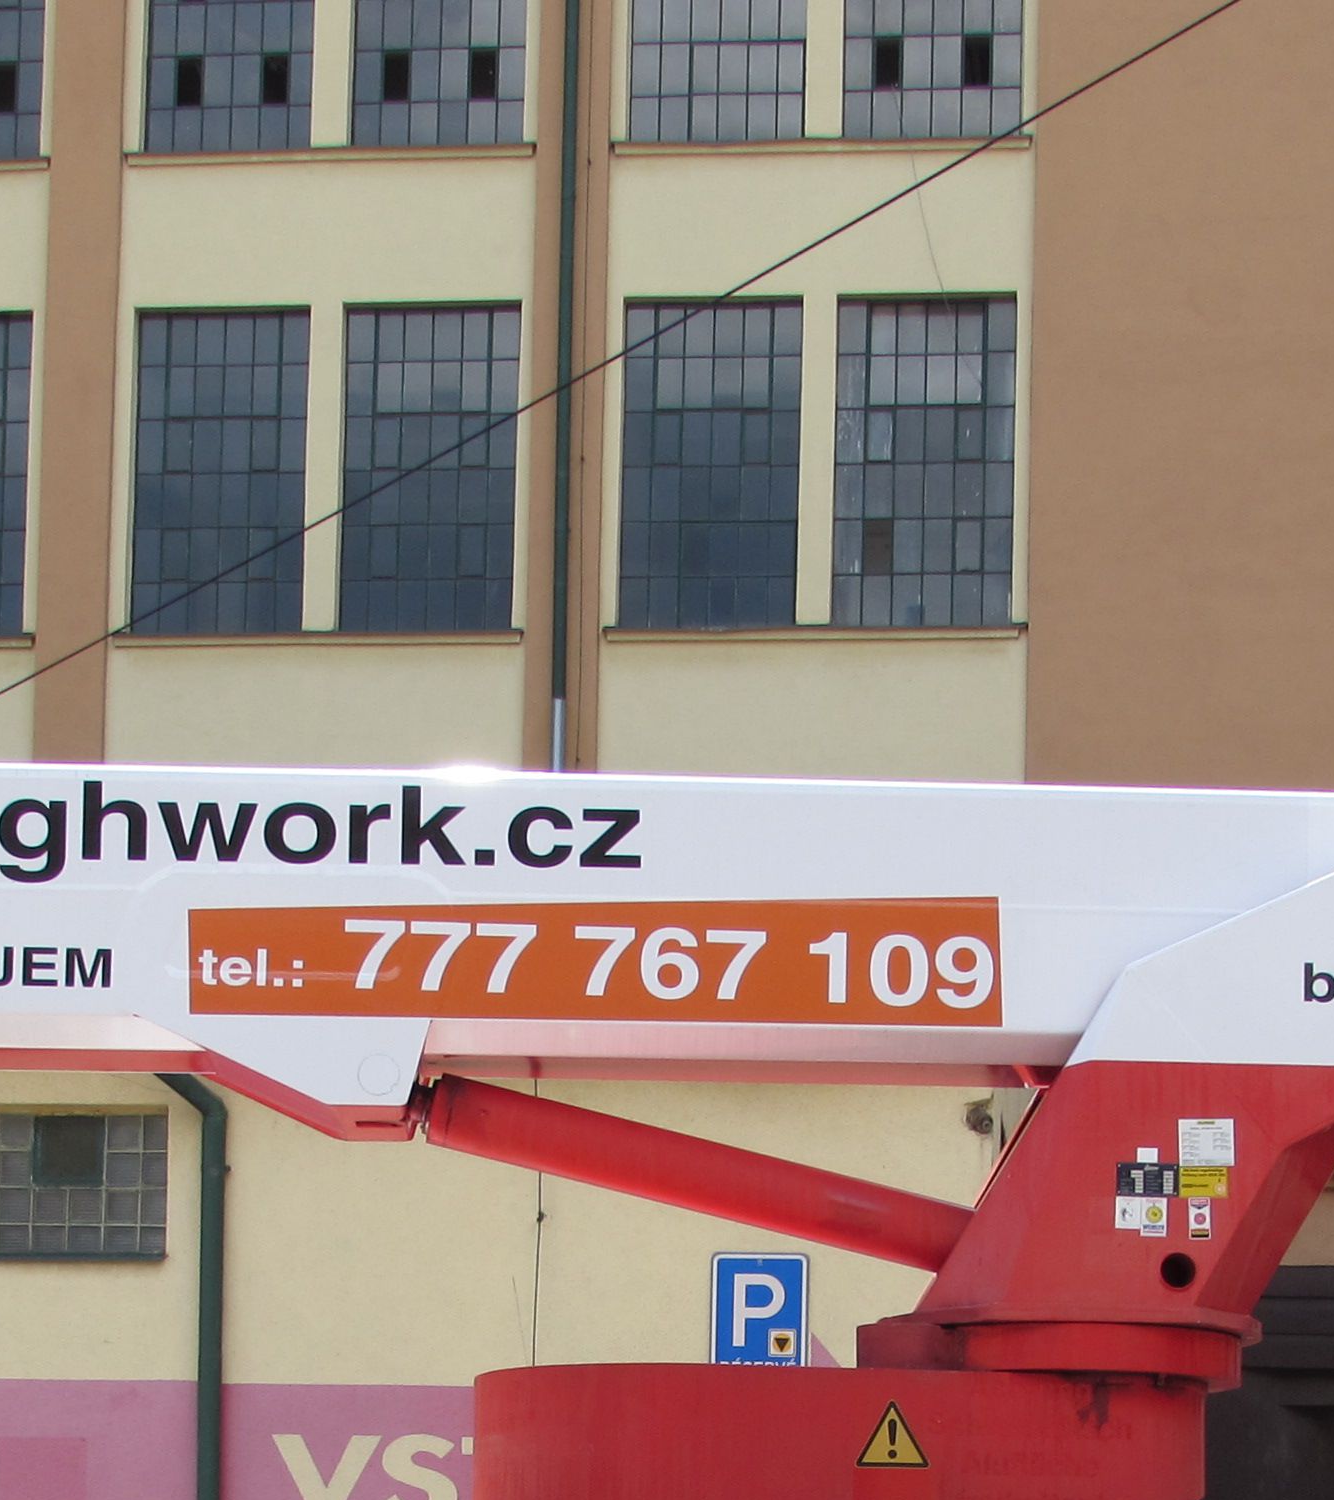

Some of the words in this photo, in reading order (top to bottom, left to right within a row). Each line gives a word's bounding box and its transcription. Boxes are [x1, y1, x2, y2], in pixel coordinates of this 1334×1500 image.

[198, 949, 304, 988] tel.:
[345, 918, 537, 993] 777
[574, 926, 768, 1001] 767
[809, 931, 994, 1008] 109
[732, 1273, 786, 1347] P
